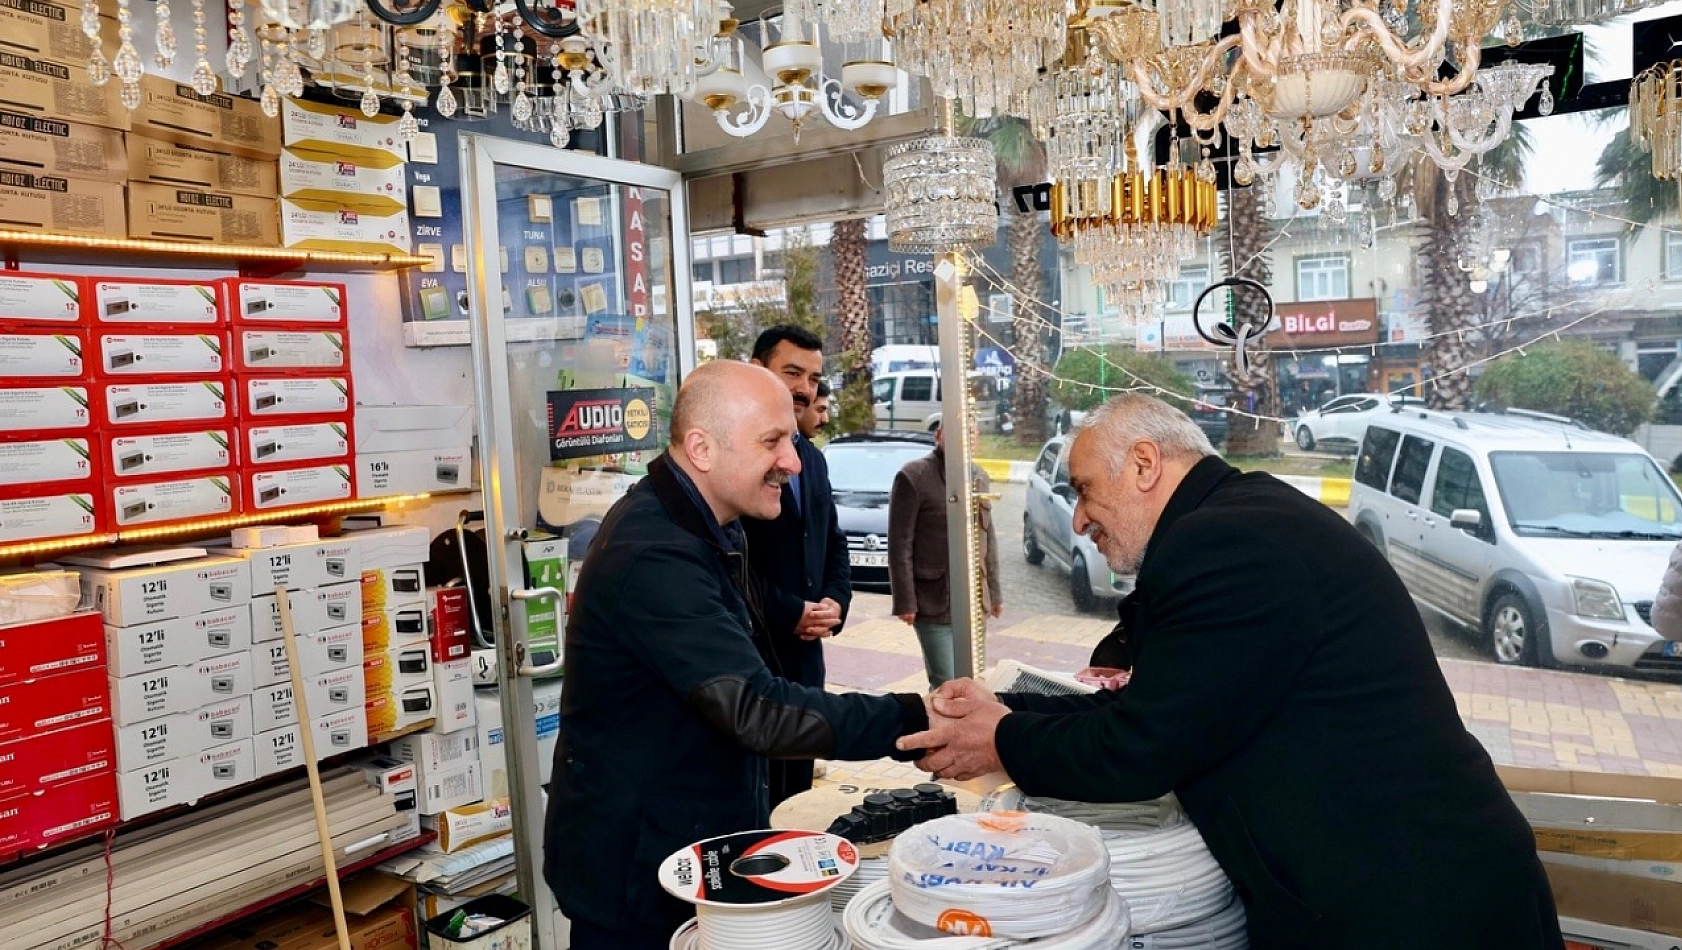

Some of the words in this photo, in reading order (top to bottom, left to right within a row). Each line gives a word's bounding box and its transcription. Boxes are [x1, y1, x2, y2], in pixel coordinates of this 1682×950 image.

[416, 224, 442, 237] ZİRVE
[524, 230, 546, 240] TUNA
[421, 278, 439, 288] EVA
[66, 303, 75, 311] 12
[1285, 310, 1335, 333] BİLGİ
[557, 401, 623, 436] AUDIO
[77, 461, 86, 469] 12
[269, 554, 291, 567] 12'li
[209, 568, 238, 577] babacan
[141, 580, 167, 593] 12'li
[207, 614, 236, 624] babacan
[138, 629, 165, 644] 12'li
[210, 660, 240, 671] babacan
[142, 676, 168, 692] 12'li
[270, 688, 293, 702] 12'li
[141, 723, 167, 740] 12'li
[272, 732, 294, 748] 12'li
[144, 768, 170, 784] 12'li
[673, 857, 693, 887] wellbox
